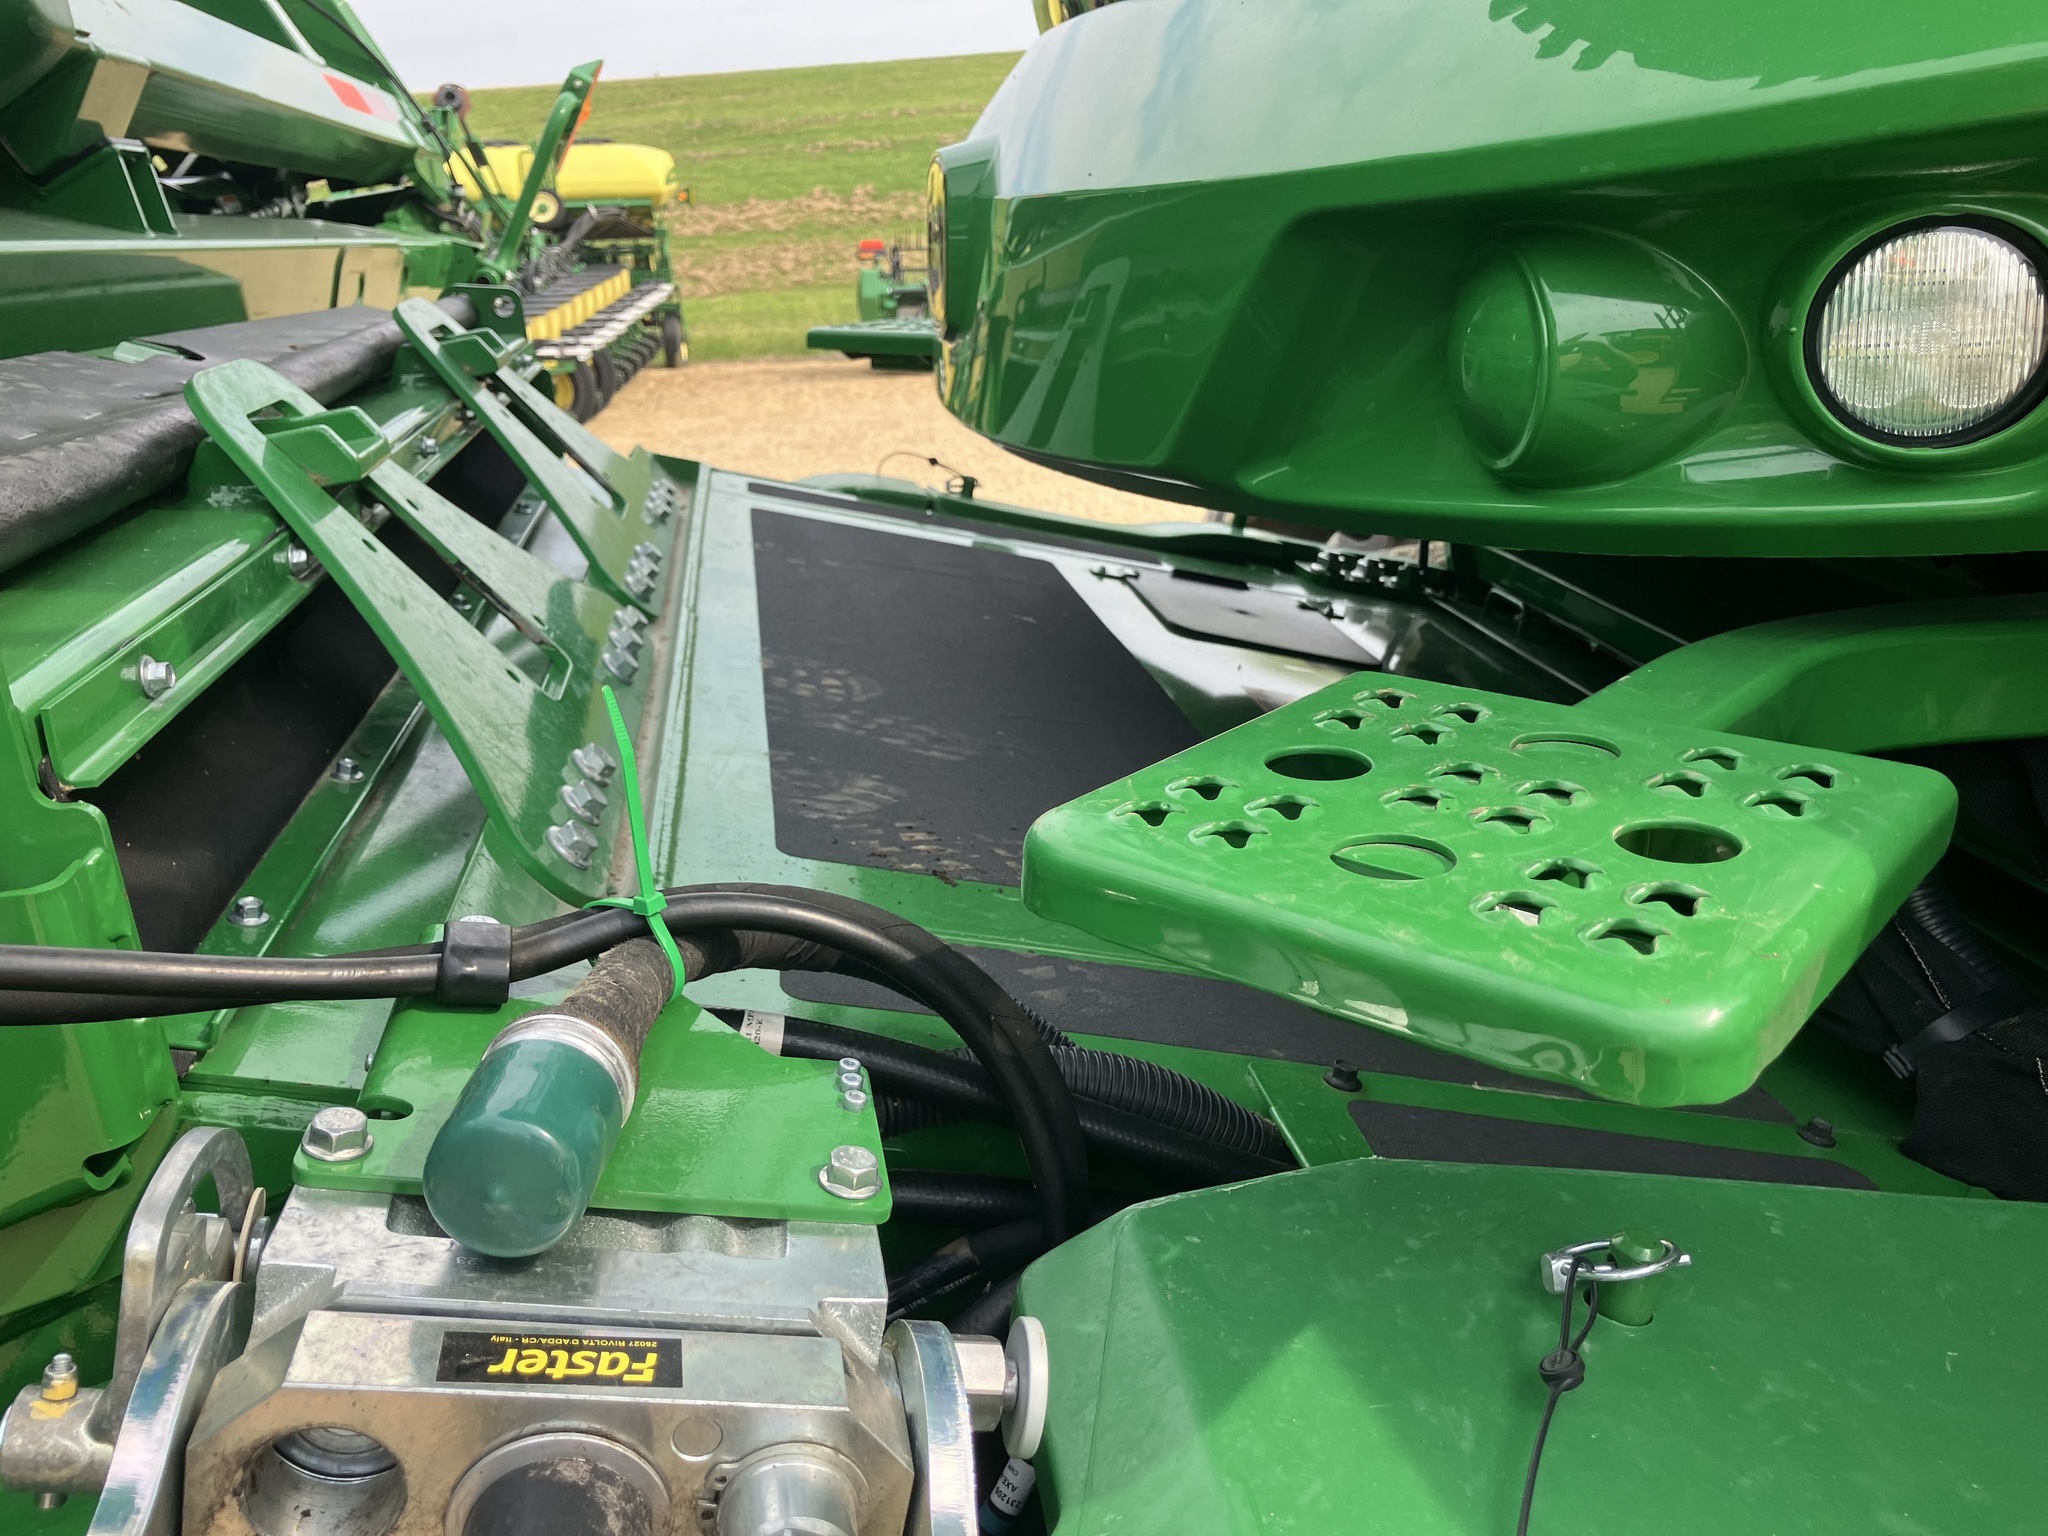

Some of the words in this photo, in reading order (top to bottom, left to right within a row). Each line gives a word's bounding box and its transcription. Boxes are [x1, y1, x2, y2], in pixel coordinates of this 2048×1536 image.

[490, 1335, 512, 1343] Italy
[521, 1337, 580, 1345] D'ADDA/CR
[581, 1338, 626, 1347] RIVOLTA
[628, 1340, 658, 1348] 26027
[487, 1347, 658, 1383] Faster
